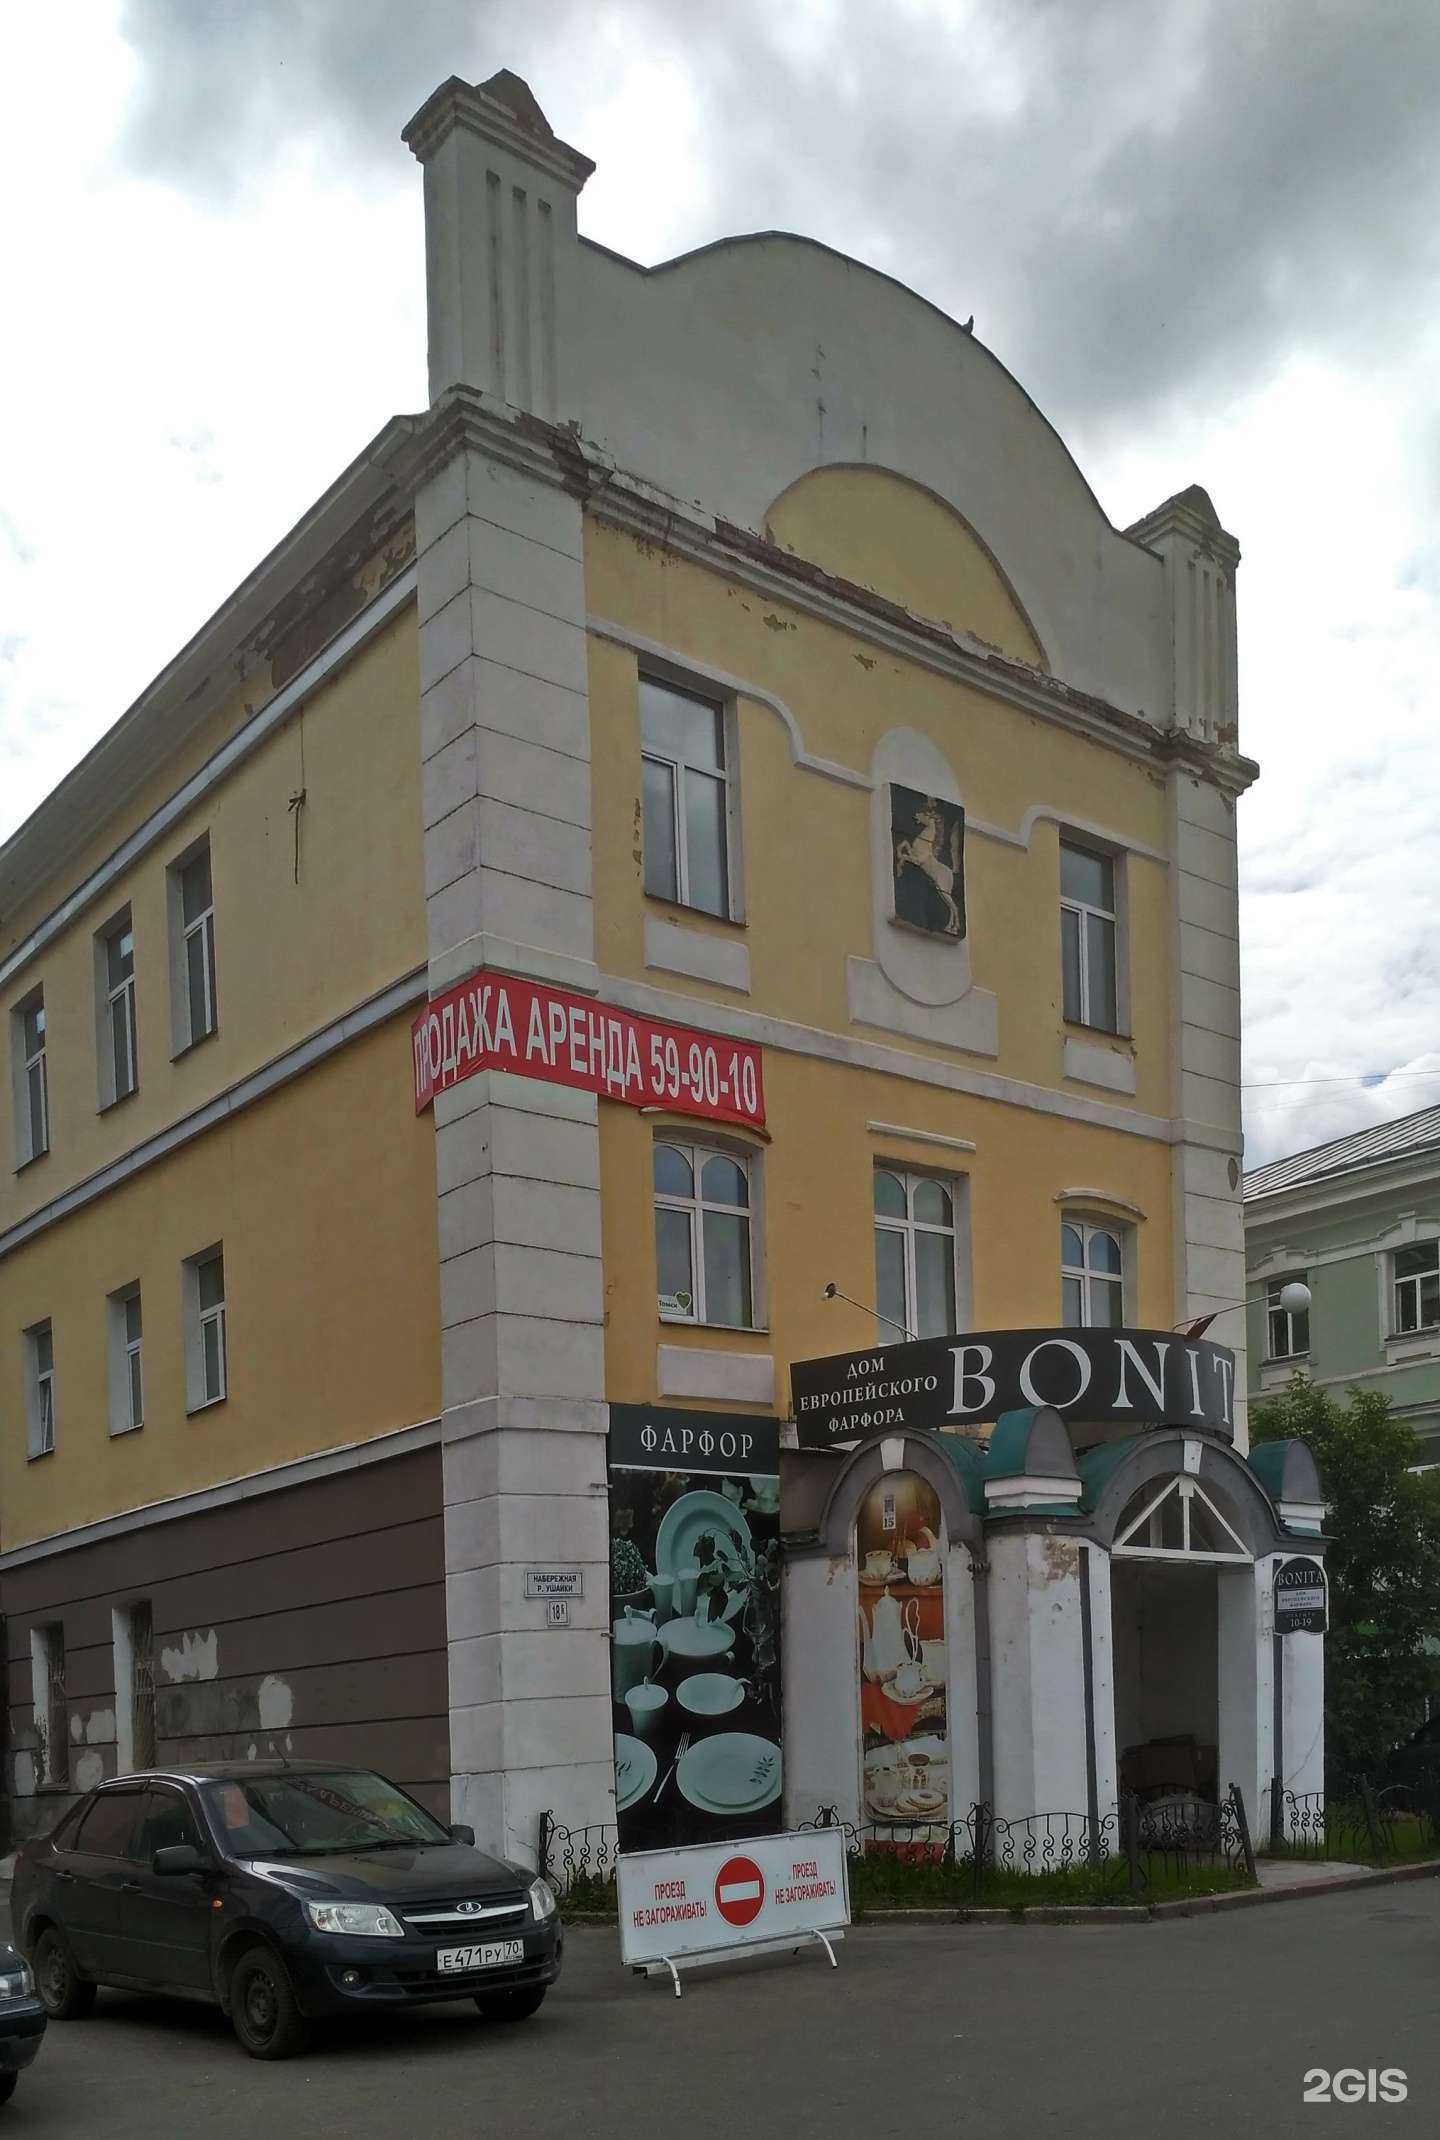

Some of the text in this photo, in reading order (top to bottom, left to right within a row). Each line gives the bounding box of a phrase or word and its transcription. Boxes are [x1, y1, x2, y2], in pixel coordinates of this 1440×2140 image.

[413, 984, 757, 1114] ПРОДАЖА АРЕНДА 59-90-10
[847, 1356, 885, 1380] ДОМ
[800, 1375, 938, 1411] ЕВРОПЕЙСКОГО
[828, 1407, 905, 1433] ФАРФОРА
[640, 1424, 753, 1459] ФАРФОР
[533, 1574, 577, 1583] НАБЕРЕЖНАЯ
[1278, 1570, 1323, 1586] BONITA
[792, 1861, 818, 1880] ПРОЕЗД
[654, 1880, 686, 1900] ПРОЕЗД
[775, 1880, 837, 1905] НЕ ЗАГОРАЖИВАТЬ!
[633, 1900, 708, 1928] НЕ ЗАГОРАЖИВАТЬ!
